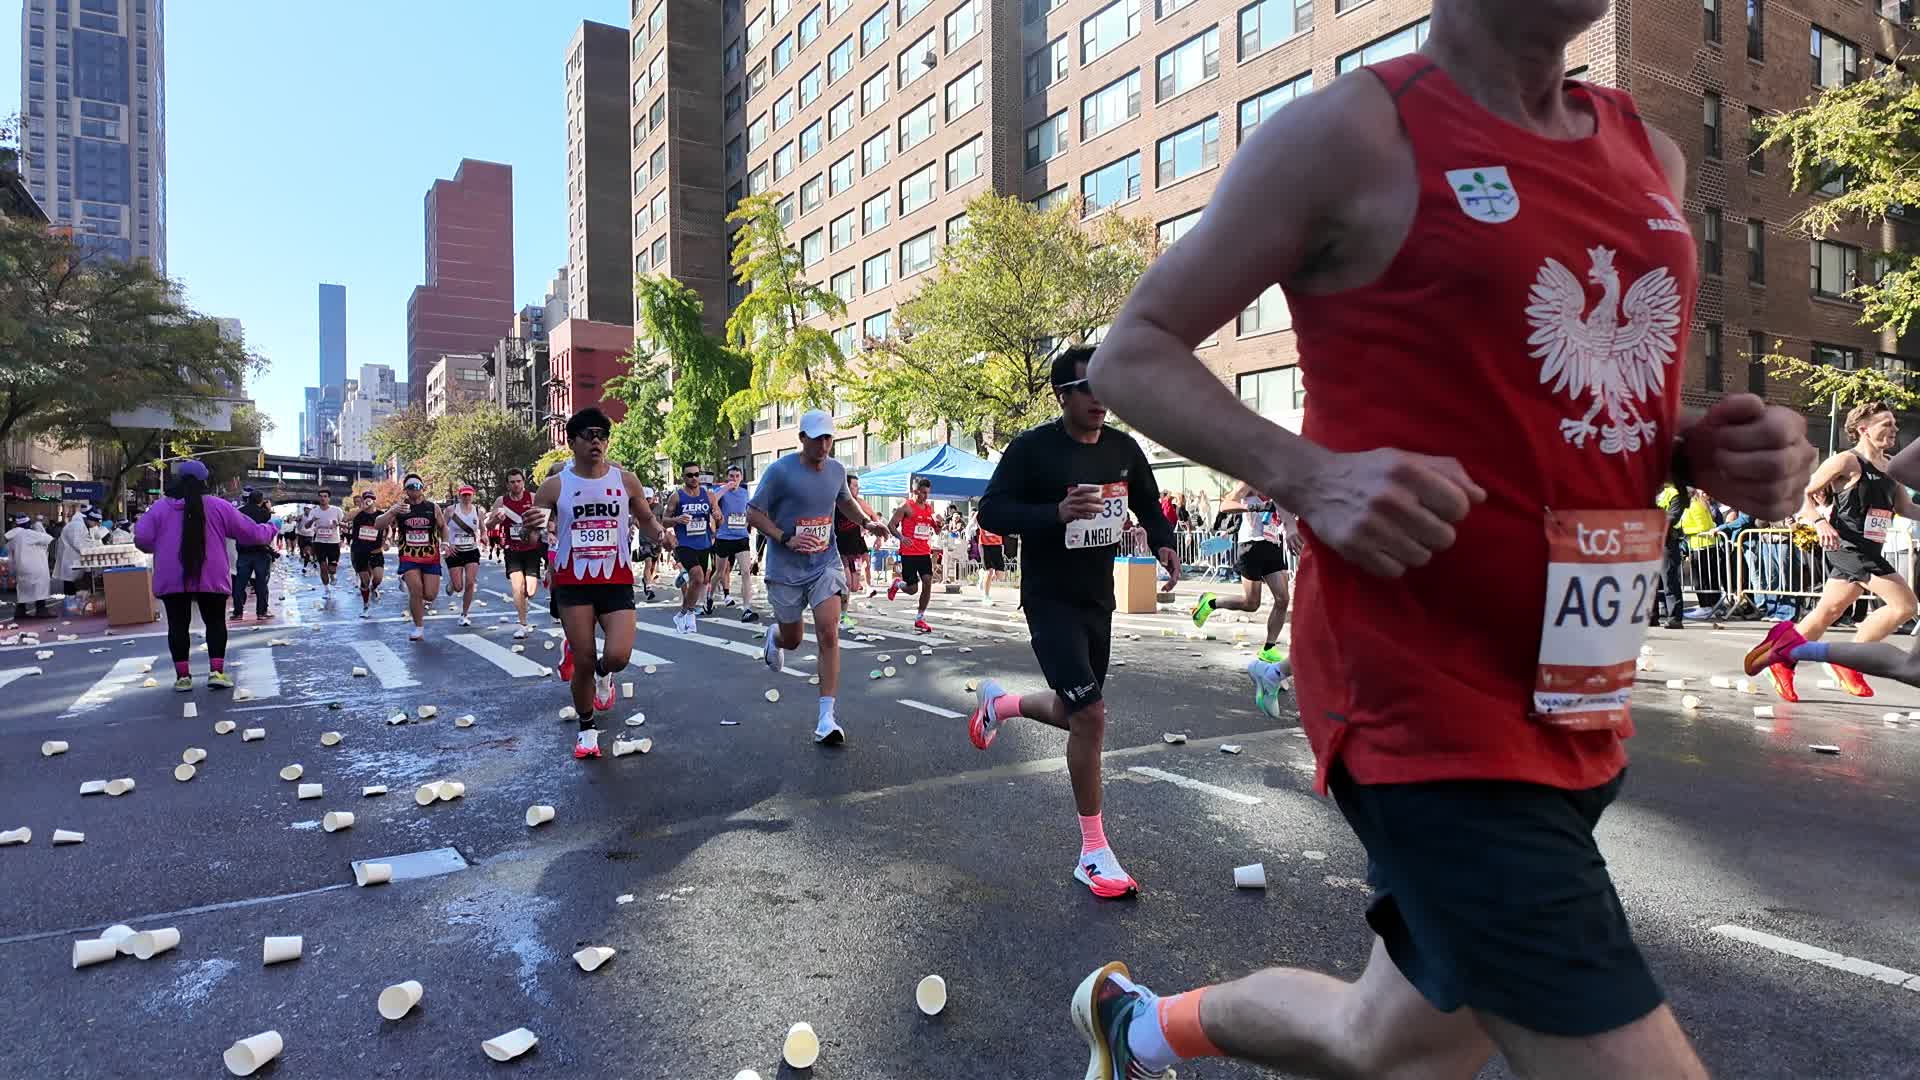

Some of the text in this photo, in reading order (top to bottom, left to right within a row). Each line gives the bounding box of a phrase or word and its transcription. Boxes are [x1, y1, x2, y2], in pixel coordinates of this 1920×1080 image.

[573, 501, 620, 519] PERÚ
[681, 503, 709, 512] ZERO
[580, 529, 610, 542] 5981
[1083, 527, 1113, 546] ANGEL
[1577, 522, 1621, 555] tcs
[1554, 573, 1660, 628] AG 2
